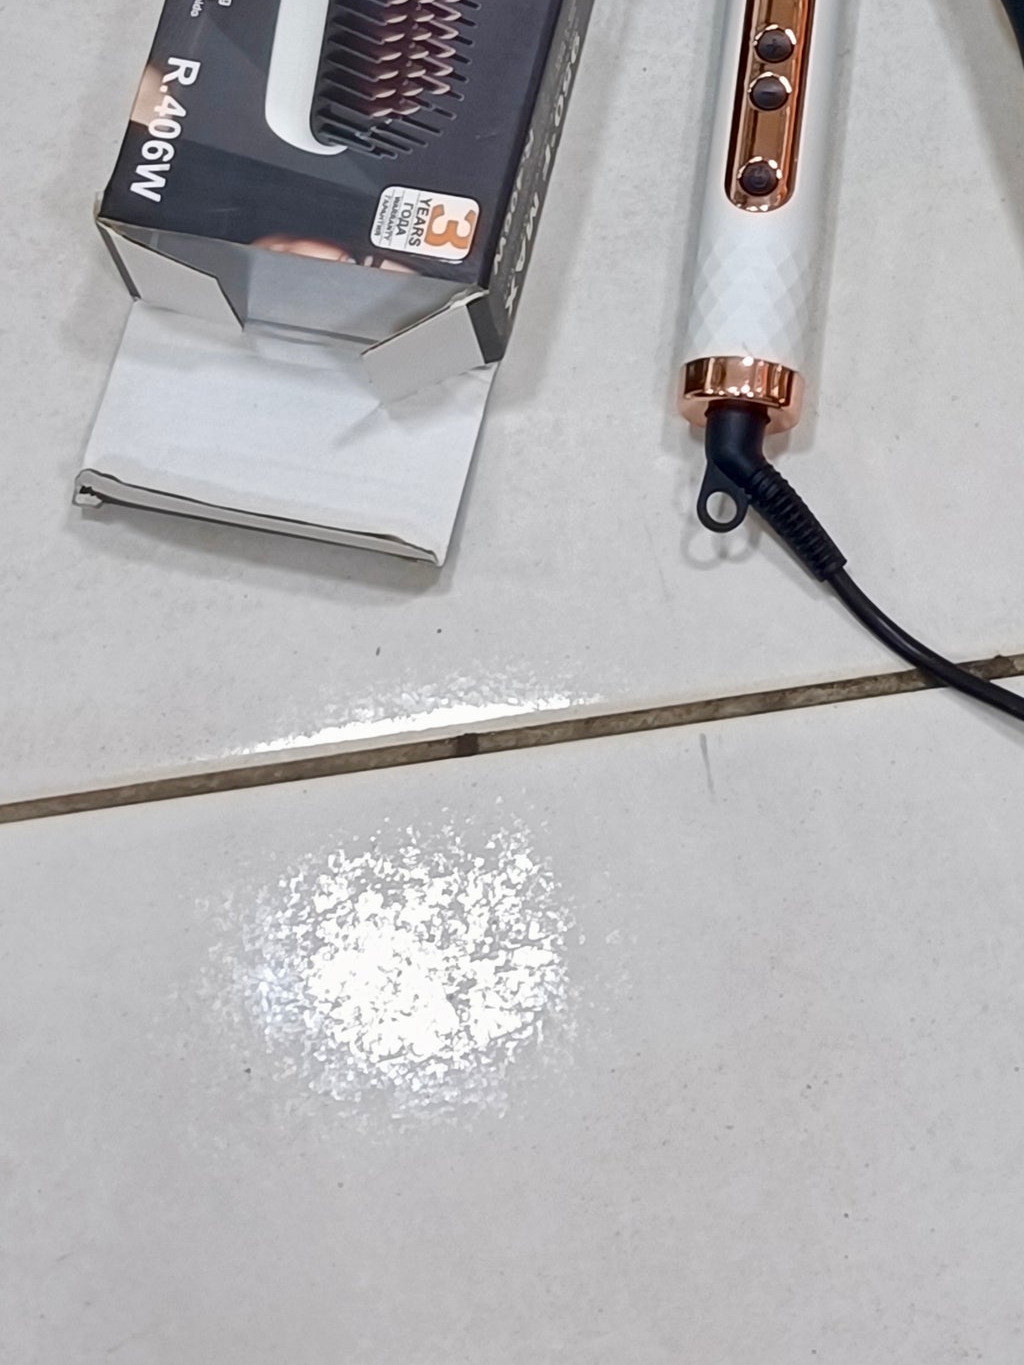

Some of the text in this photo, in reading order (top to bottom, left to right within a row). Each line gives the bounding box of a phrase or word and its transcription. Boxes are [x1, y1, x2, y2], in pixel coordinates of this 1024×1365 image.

[130, 56, 201, 203] R.406W
[394, 201, 413, 236] ГОДА
[407, 197, 431, 247] YEARS
[424, 204, 477, 251] 3
